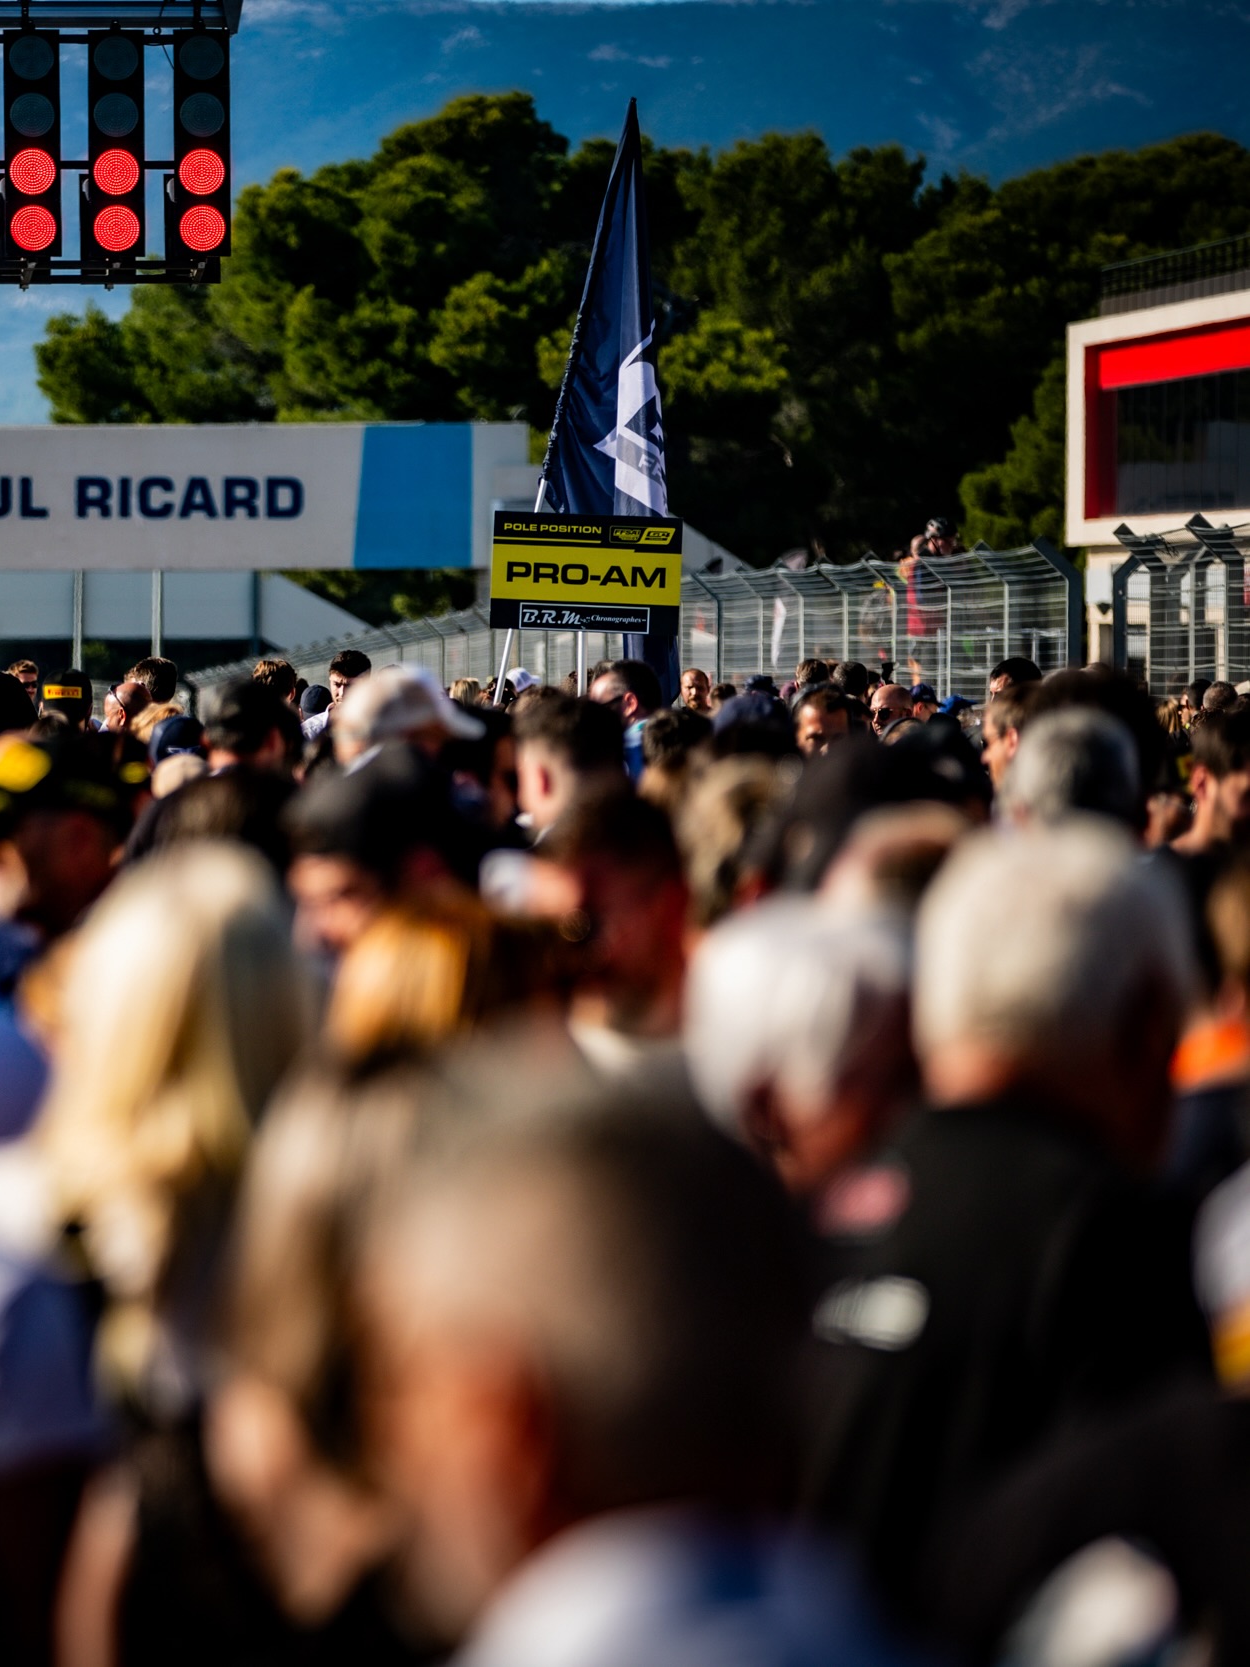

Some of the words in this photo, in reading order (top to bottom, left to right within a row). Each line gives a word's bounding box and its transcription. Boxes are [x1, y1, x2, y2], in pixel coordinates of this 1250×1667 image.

[76, 476, 305, 519] RICARD
[504, 523, 538, 532] POLE
[540, 524, 602, 534] POSITION
[506, 561, 666, 588] PRO-AM
[591, 614, 642, 624] Chronographes
